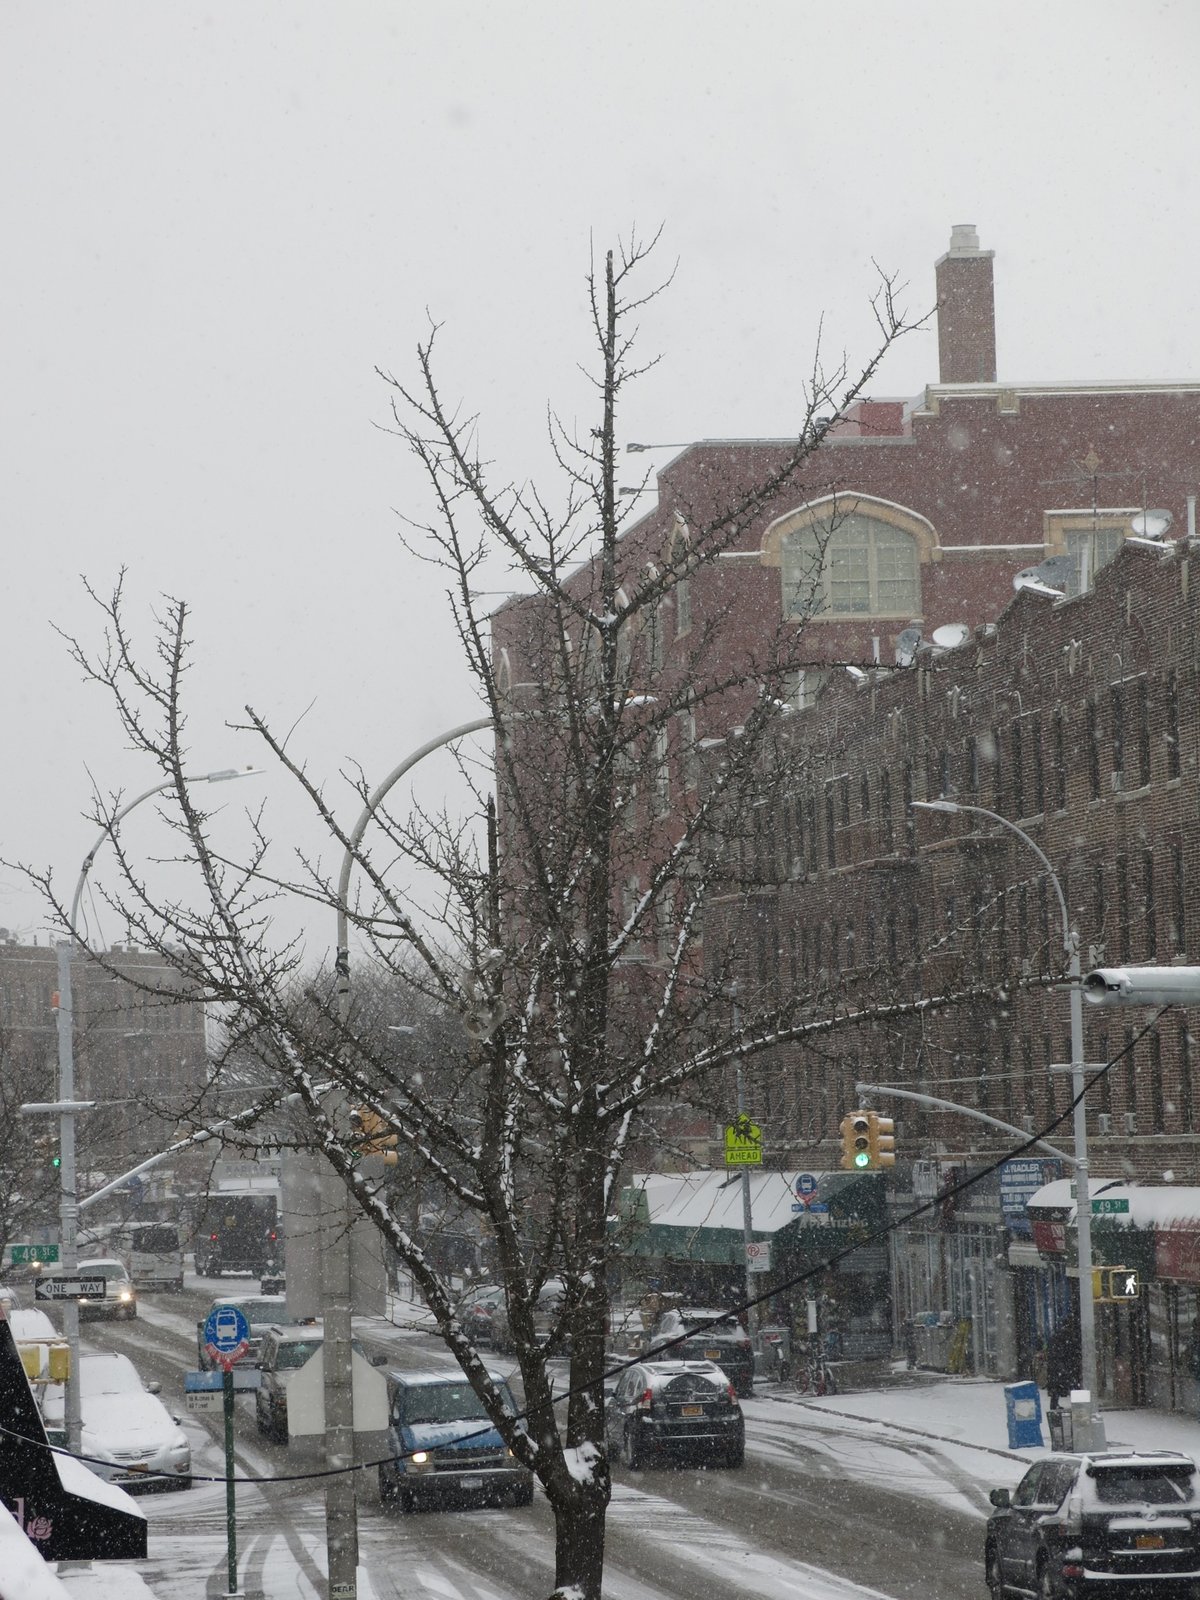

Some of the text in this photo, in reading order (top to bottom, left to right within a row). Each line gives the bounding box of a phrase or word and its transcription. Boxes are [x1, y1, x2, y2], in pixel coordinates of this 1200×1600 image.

[730, 1152, 758, 1161] AHEAD
[1011, 1163, 1040, 1173] NADLER
[1099, 1201, 1111, 1212] 49
[22, 1247, 37, 1261] 49
[46, 1283, 100, 1293] ONE WAY
